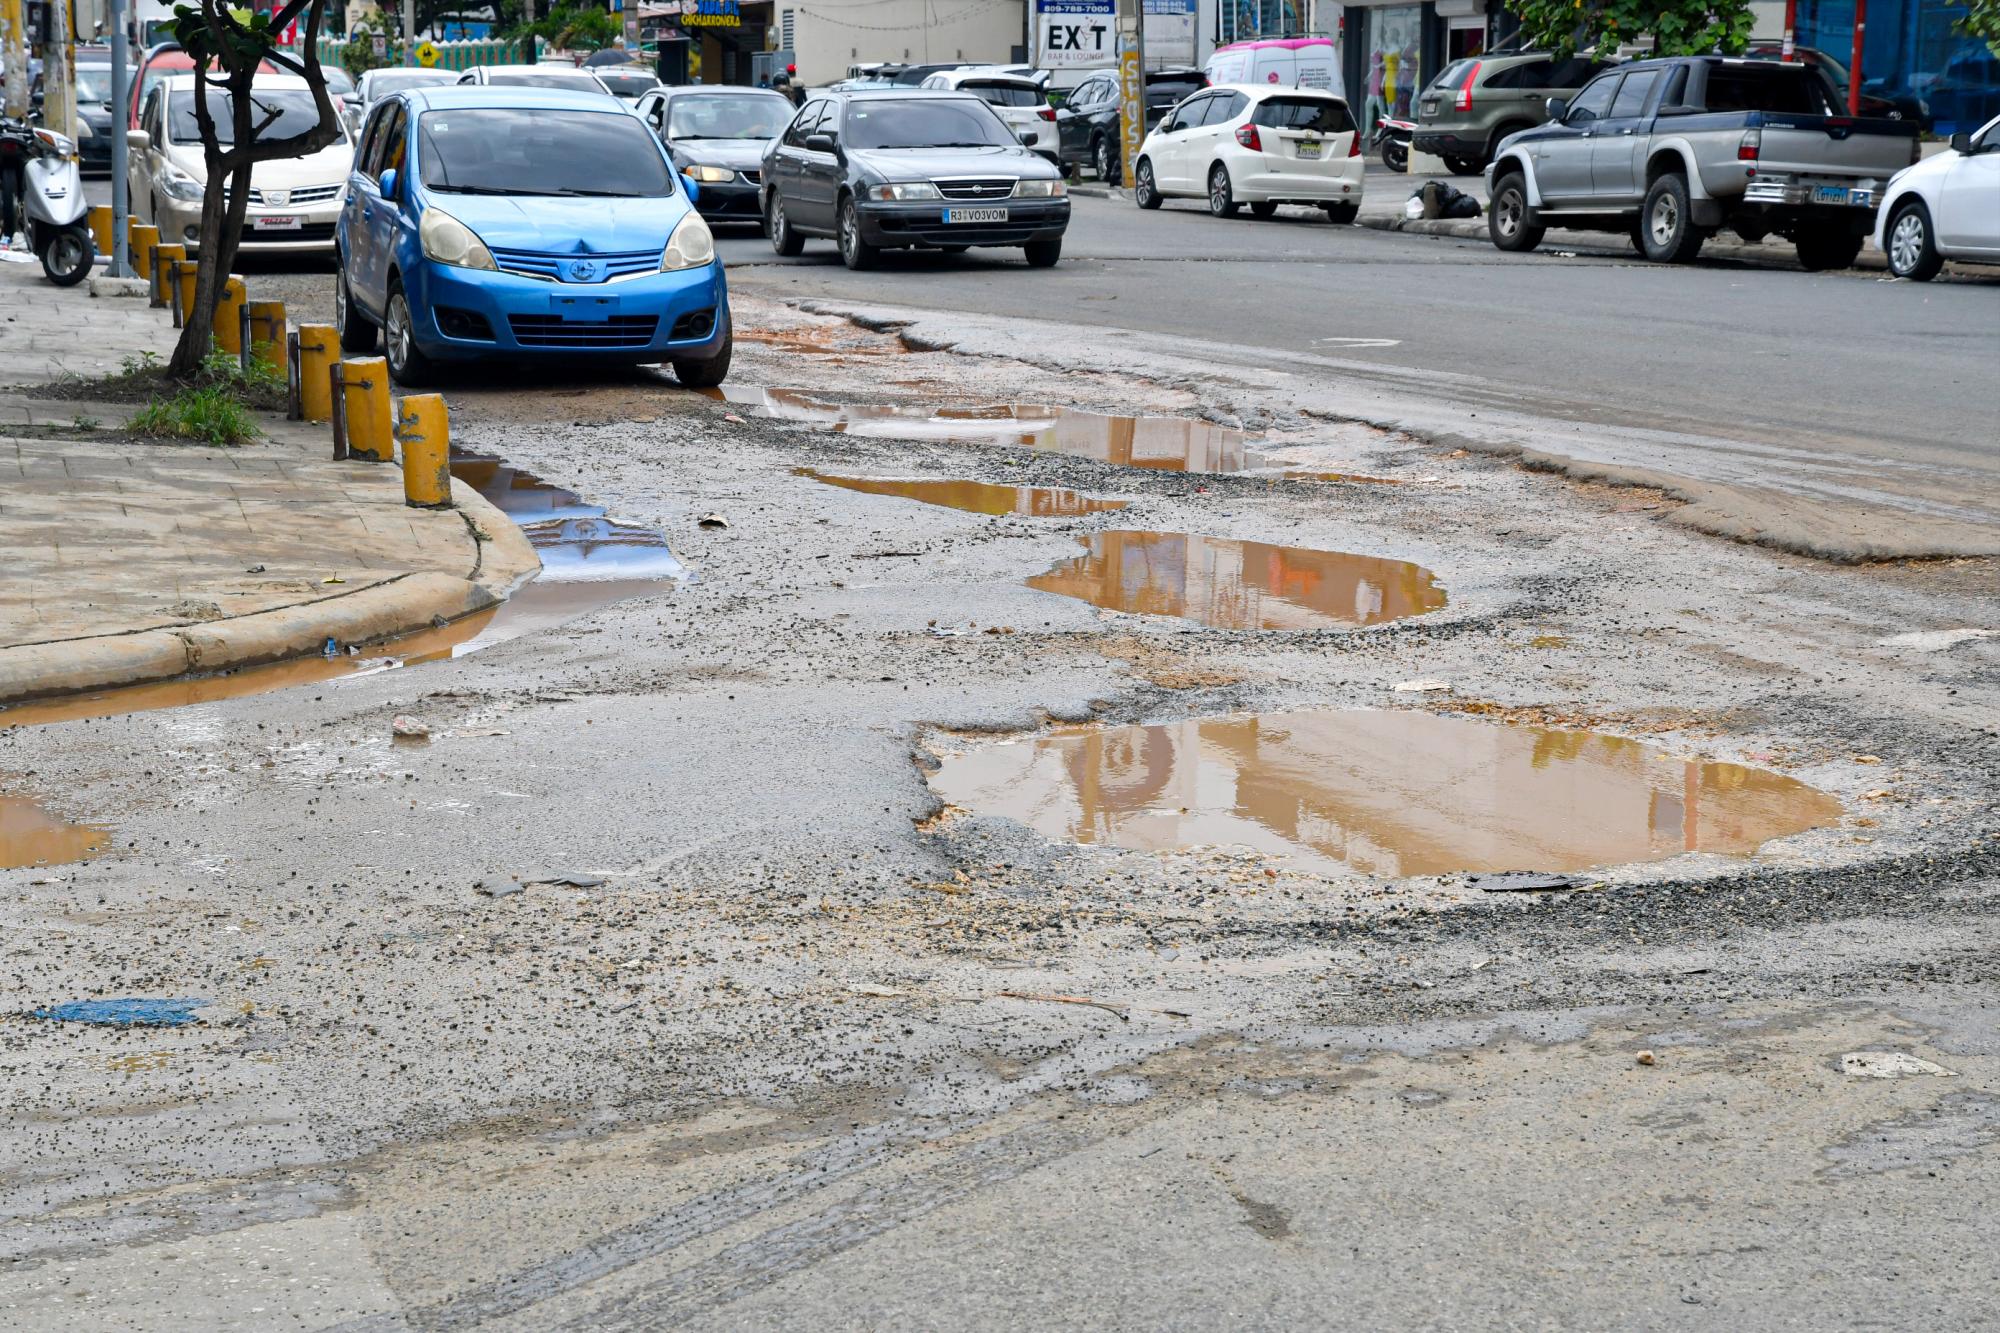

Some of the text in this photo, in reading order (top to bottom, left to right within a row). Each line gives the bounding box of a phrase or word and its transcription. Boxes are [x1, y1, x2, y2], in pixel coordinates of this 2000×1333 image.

[1044, 5, 1110, 13] 809-788-7000
[680, 15, 741, 27] CHICHARRONERA
[1047, 53, 1105, 61] BAR & LOUNGE
